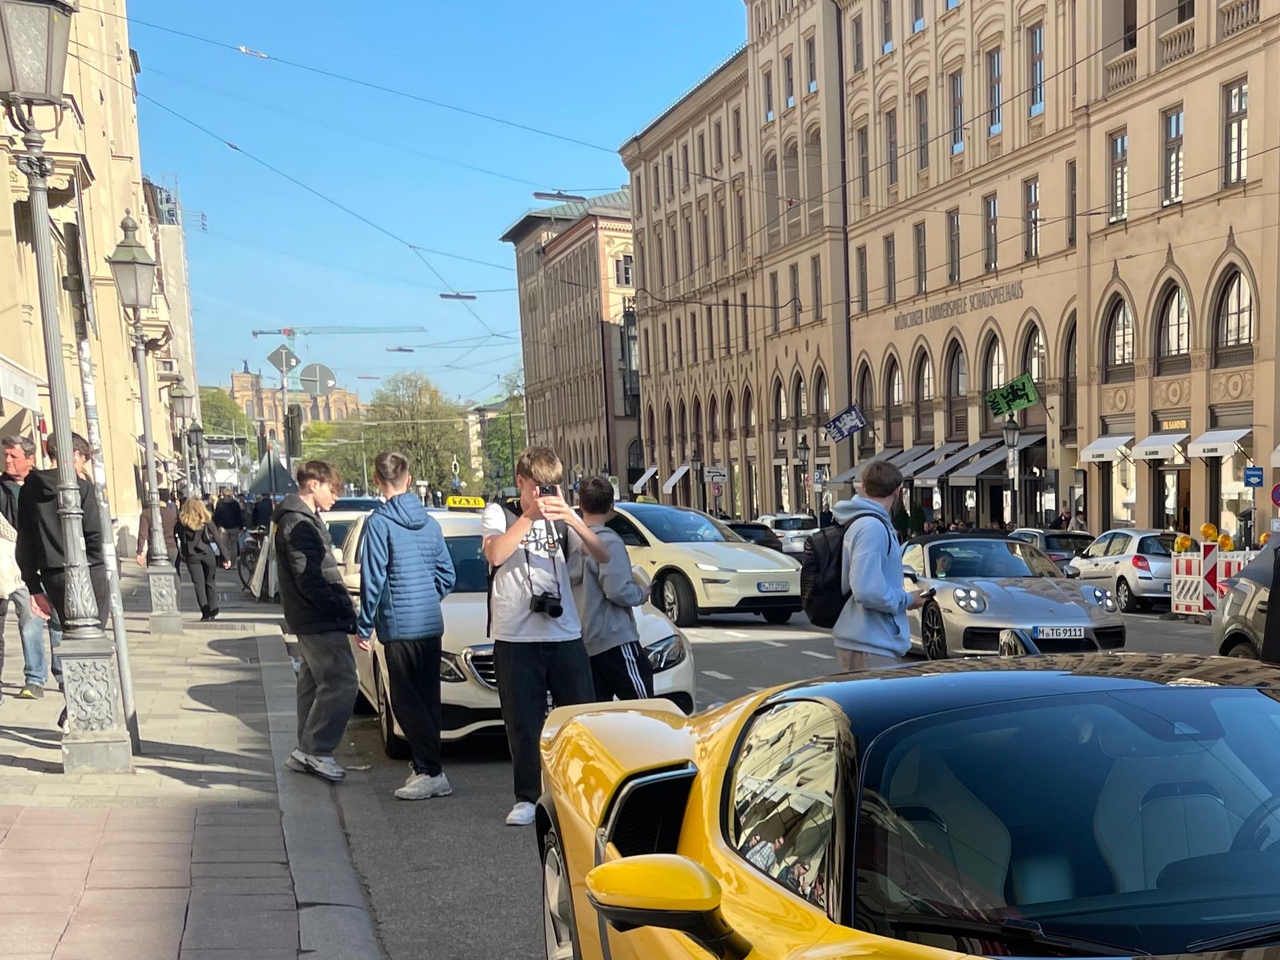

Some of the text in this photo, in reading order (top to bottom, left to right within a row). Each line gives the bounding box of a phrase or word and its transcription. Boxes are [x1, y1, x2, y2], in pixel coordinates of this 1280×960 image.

[925, 296, 967, 322] KAMMERSPIELE
[969, 280, 1023, 312] SCHAUSPIELHAUS
[1170, 419, 1187, 430] SANDER
[452, 496, 480, 506] TAXI
[1039, 628, 1083, 637] M TG 9111
